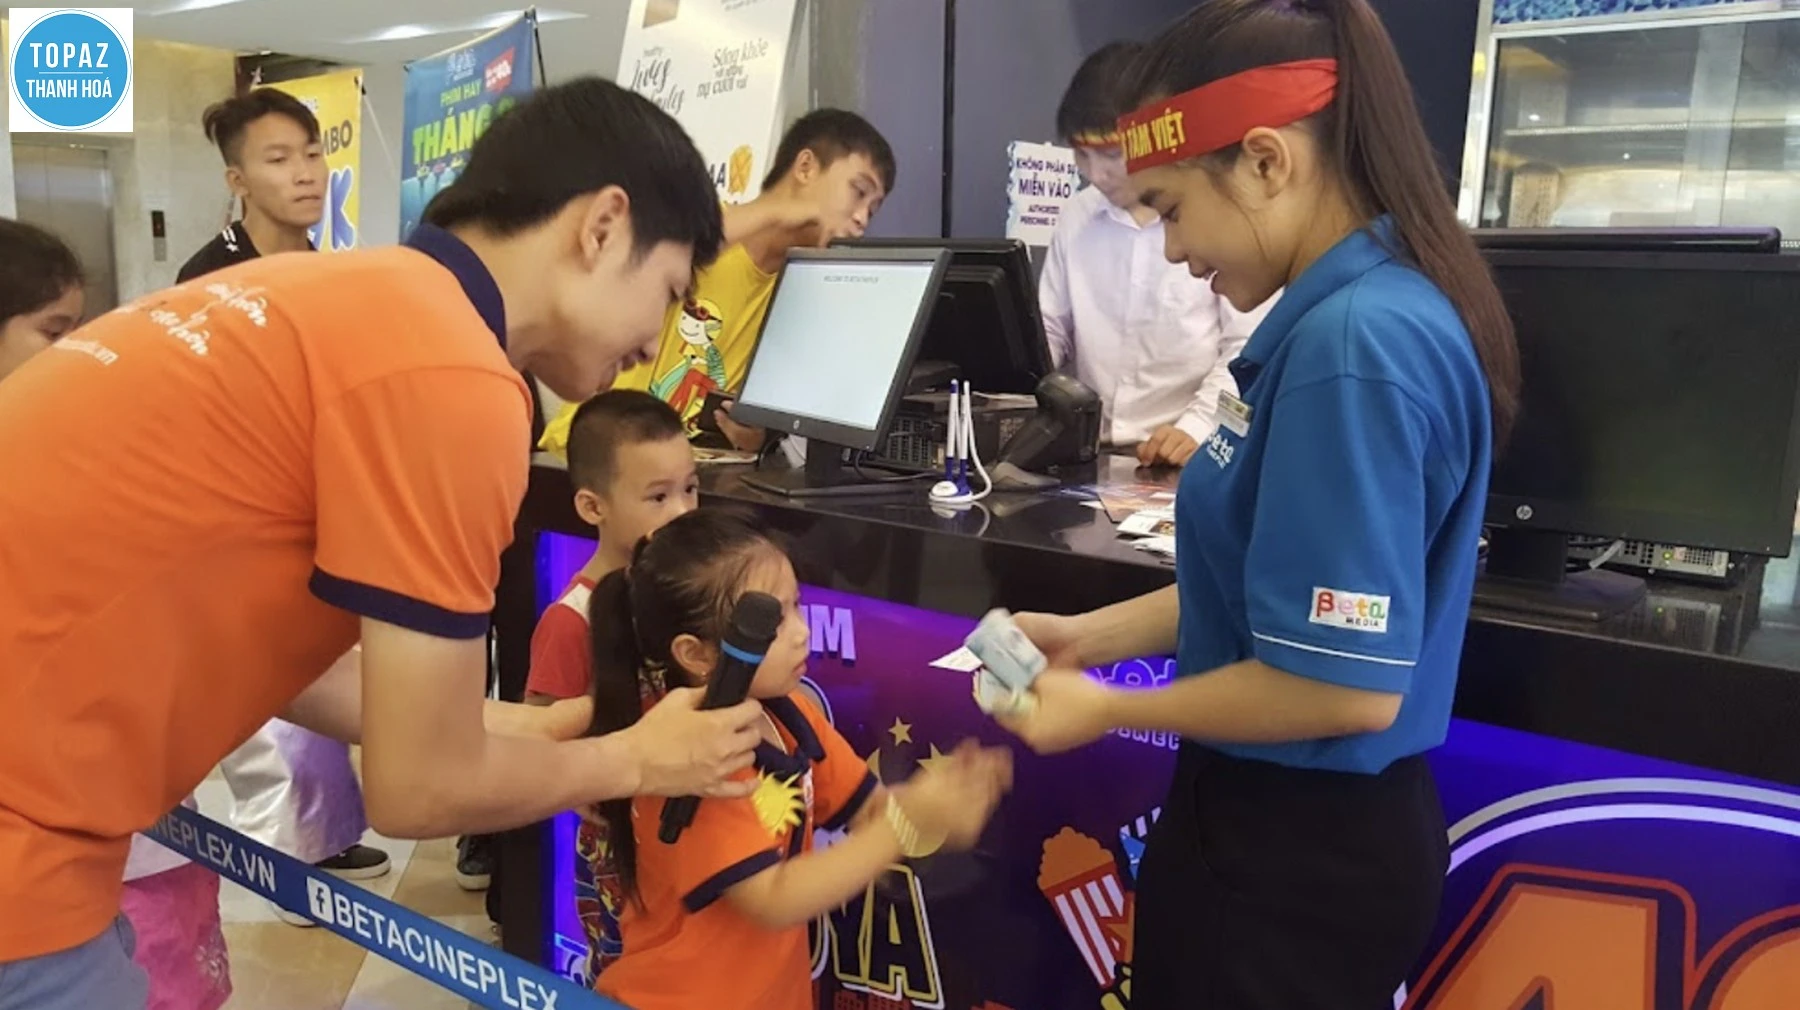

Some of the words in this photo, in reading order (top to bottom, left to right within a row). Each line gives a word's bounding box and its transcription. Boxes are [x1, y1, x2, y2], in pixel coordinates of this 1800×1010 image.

[463, 78, 483, 101] HAY
[1150, 107, 1186, 155] VIỆT
[1019, 172, 1046, 197] MIỄN
[1048, 178, 1071, 199] VÀO
[1345, 616, 1379, 627] MEDIA
[334, 894, 558, 1010] BETACINEPLEX
